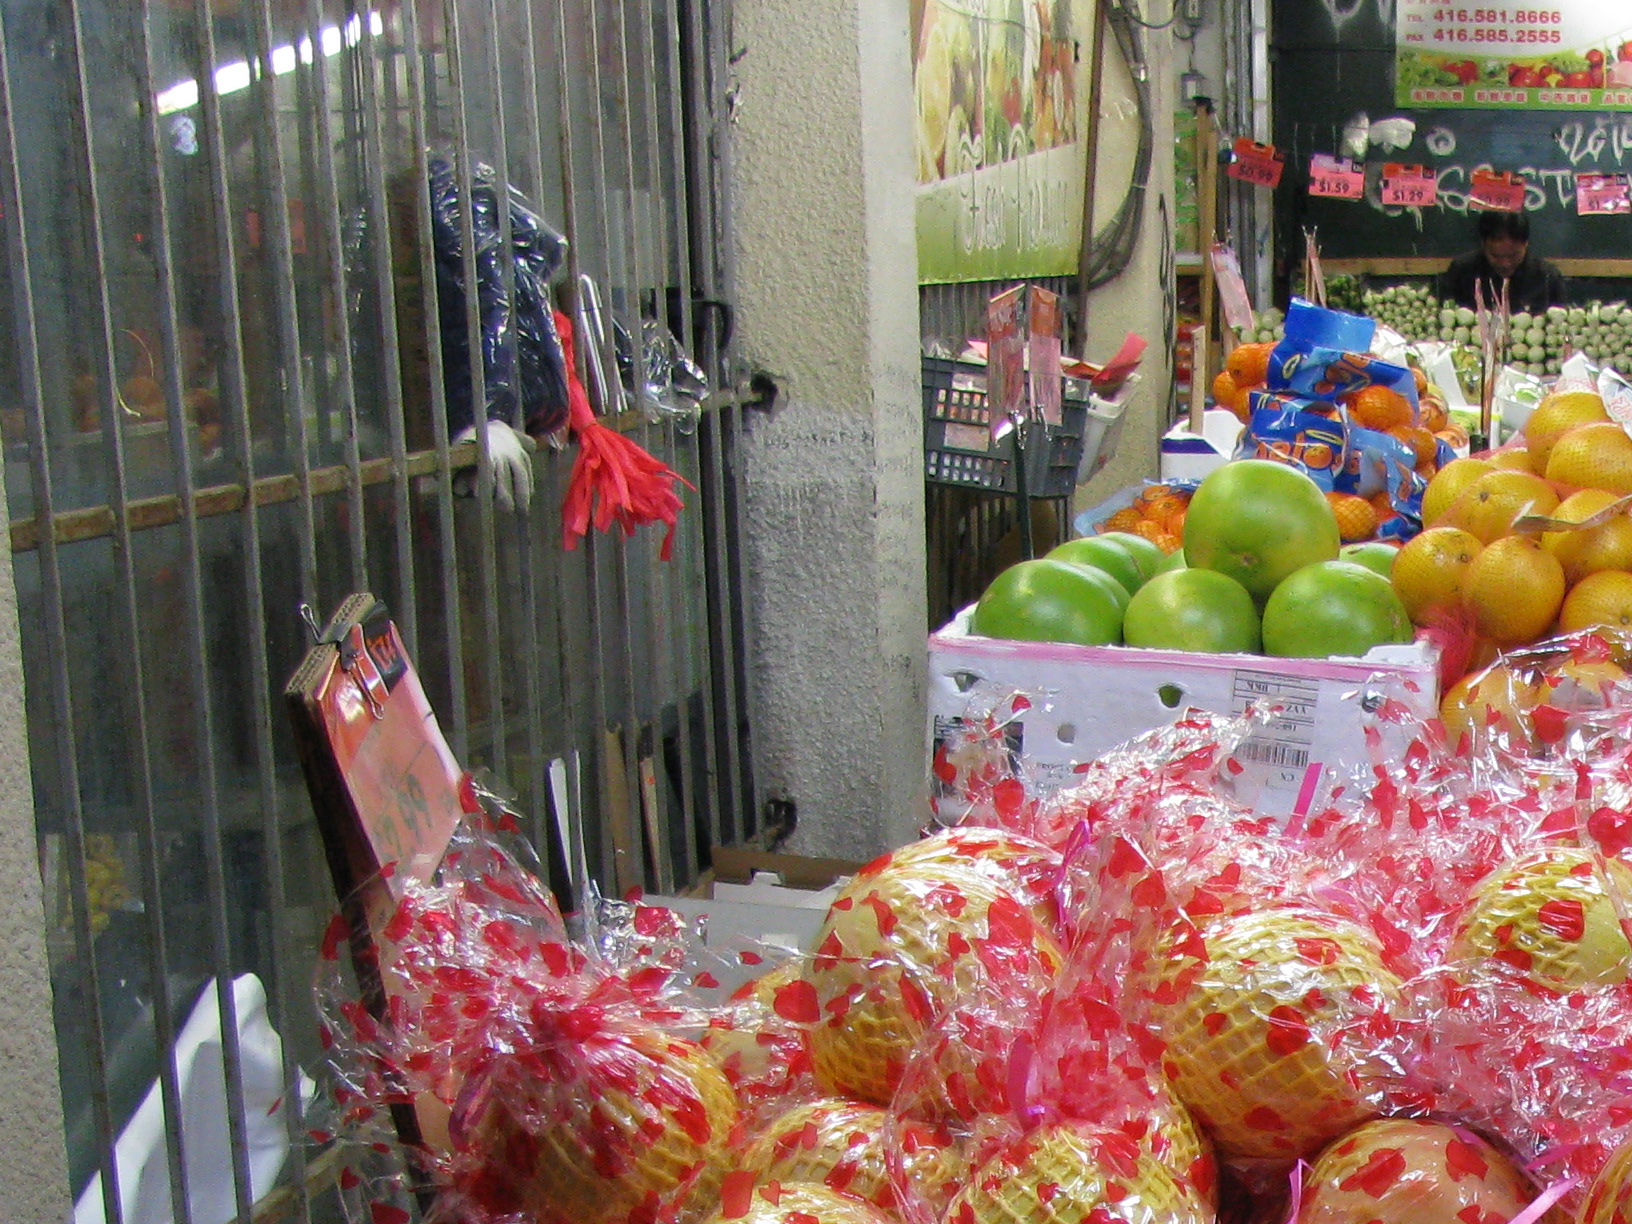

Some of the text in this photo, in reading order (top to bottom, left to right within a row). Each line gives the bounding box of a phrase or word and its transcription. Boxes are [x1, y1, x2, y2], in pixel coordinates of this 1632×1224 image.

[1433, 10, 1562, 24] 416.581.8666
[1433, 29, 1562, 43] 416.585.2555
[1318, 179, 1350, 194] $1.59
[1391, 189, 1424, 203] $1.29
